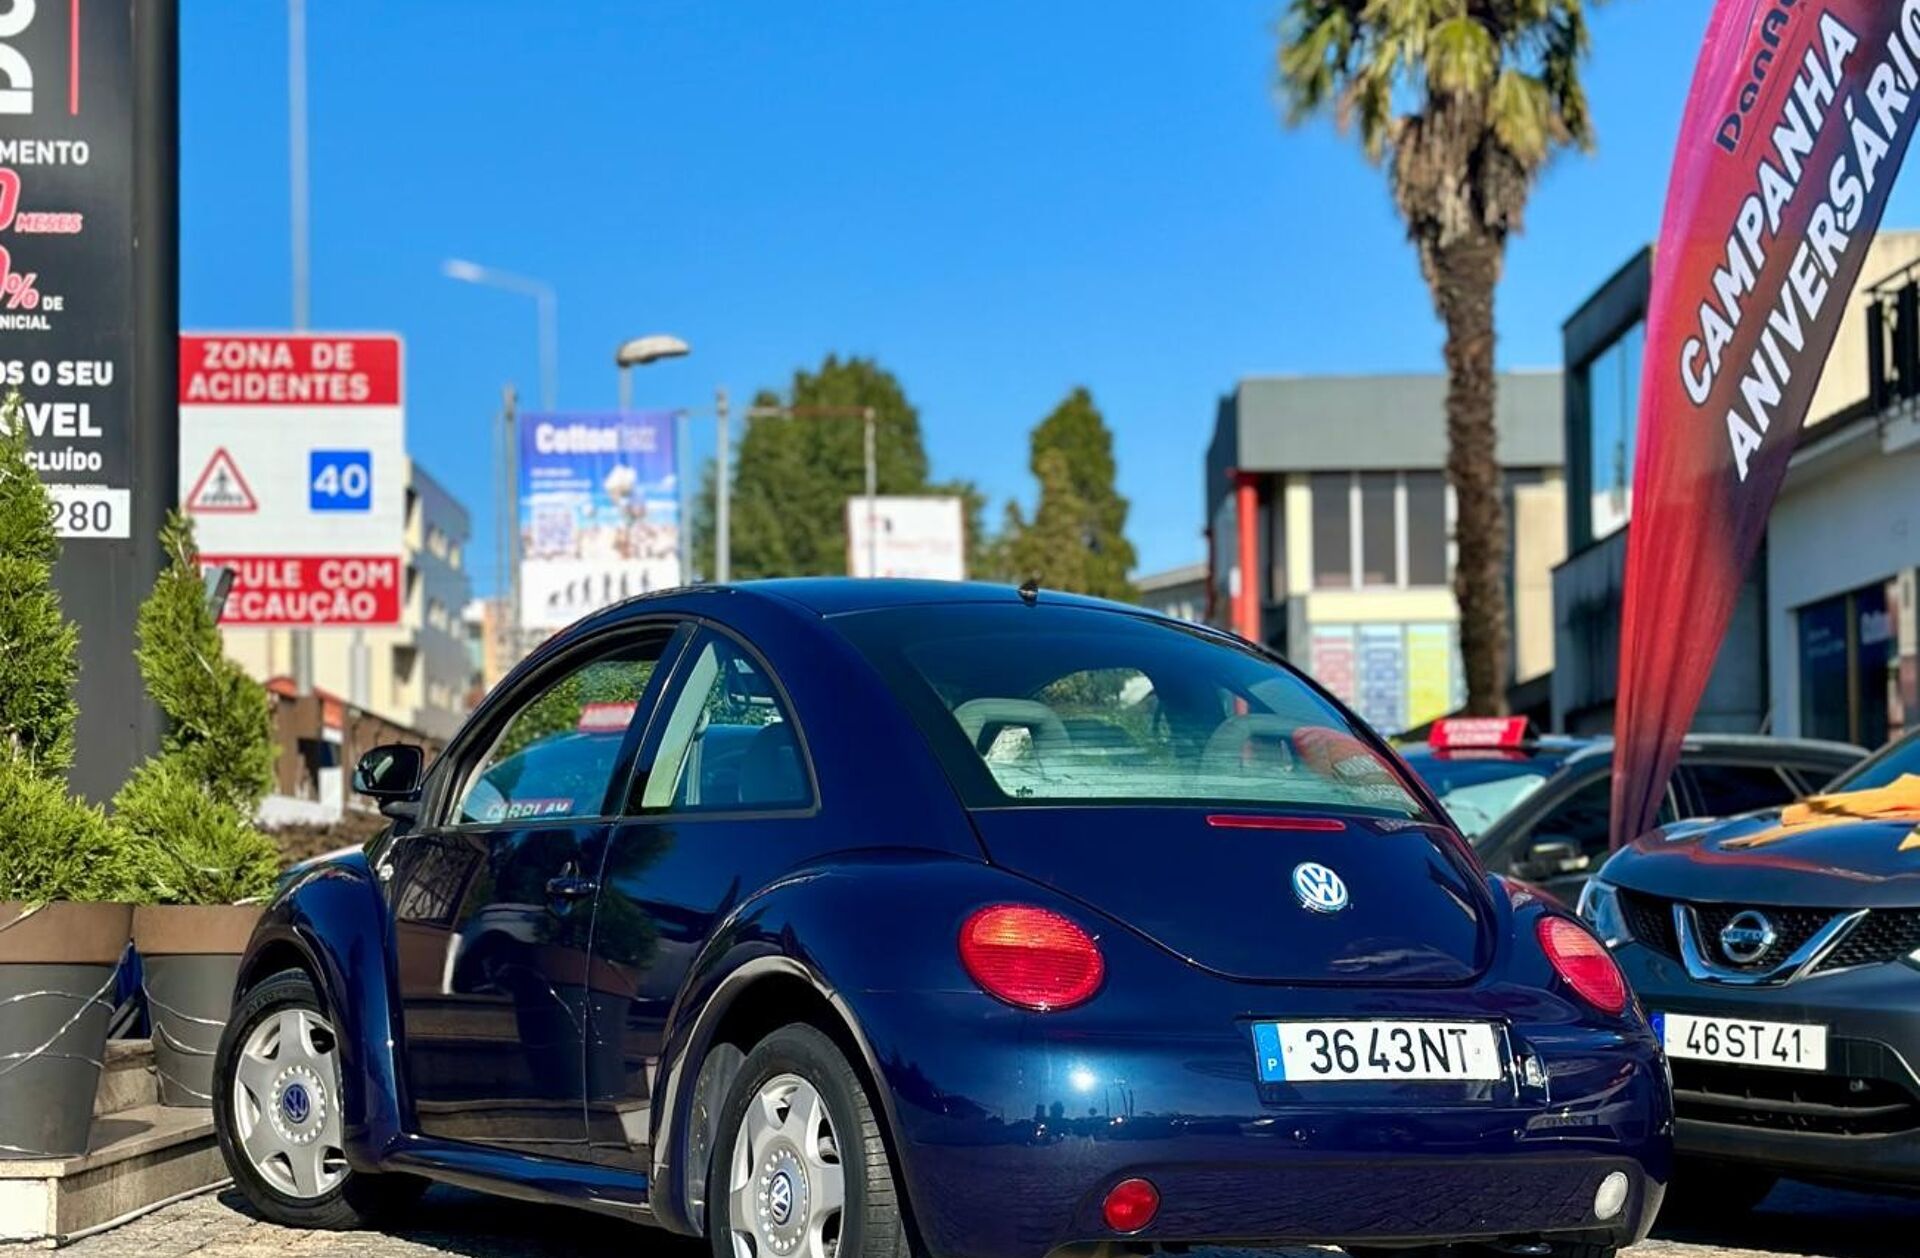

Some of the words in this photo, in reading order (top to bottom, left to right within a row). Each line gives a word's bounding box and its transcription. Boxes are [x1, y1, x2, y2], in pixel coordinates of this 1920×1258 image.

[0, 140, 90, 165] MENTO
[1680, 12, 1858, 404] CAMPANHA
[42, 296, 64, 311] DE
[202, 341, 295, 369] ZONA
[311, 342, 355, 369] DE
[31, 360, 51, 386] O
[56, 360, 114, 386] SEU
[186, 372, 372, 401] ACIDENTES
[313, 463, 369, 499] 40
[318, 560, 395, 589] COM
[1267, 1058, 1278, 1071] P
